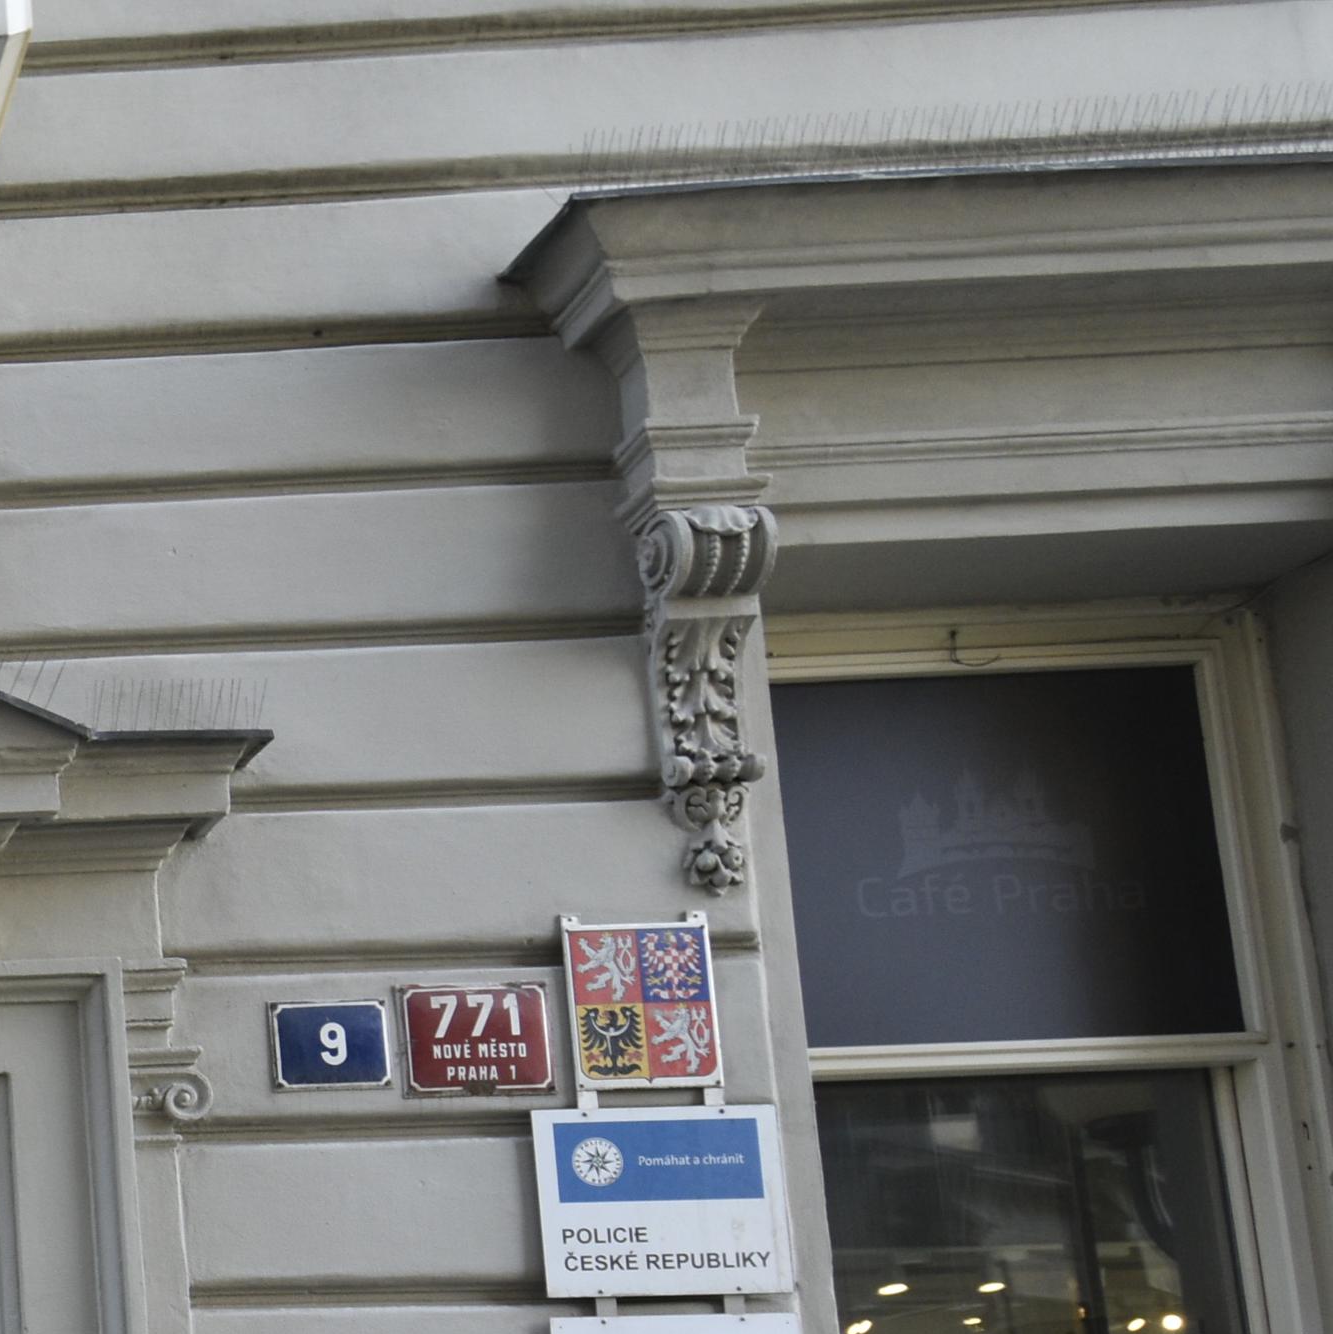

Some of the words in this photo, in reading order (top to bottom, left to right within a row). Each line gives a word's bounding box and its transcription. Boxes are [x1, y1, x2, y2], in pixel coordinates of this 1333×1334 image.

[857, 872, 973, 918] Café
[993, 872, 1146, 914] Praha
[430, 993, 521, 1039] 771
[319, 1022, 349, 1066] 9
[433, 1039, 471, 1059] NOVÉ
[478, 1038, 527, 1059] MĚSTO
[447, 1065, 499, 1081] PRAHA
[509, 1064, 516, 1080] 1
[638, 1154, 691, 1167] Pomáhat
[693, 1156, 701, 1166] a
[703, 1153, 745, 1165] chránit
[562, 1226, 649, 1245] POLICIE
[564, 1251, 639, 1272] ČESKÉ
[646, 1251, 770, 1270] REPUBLIKY
